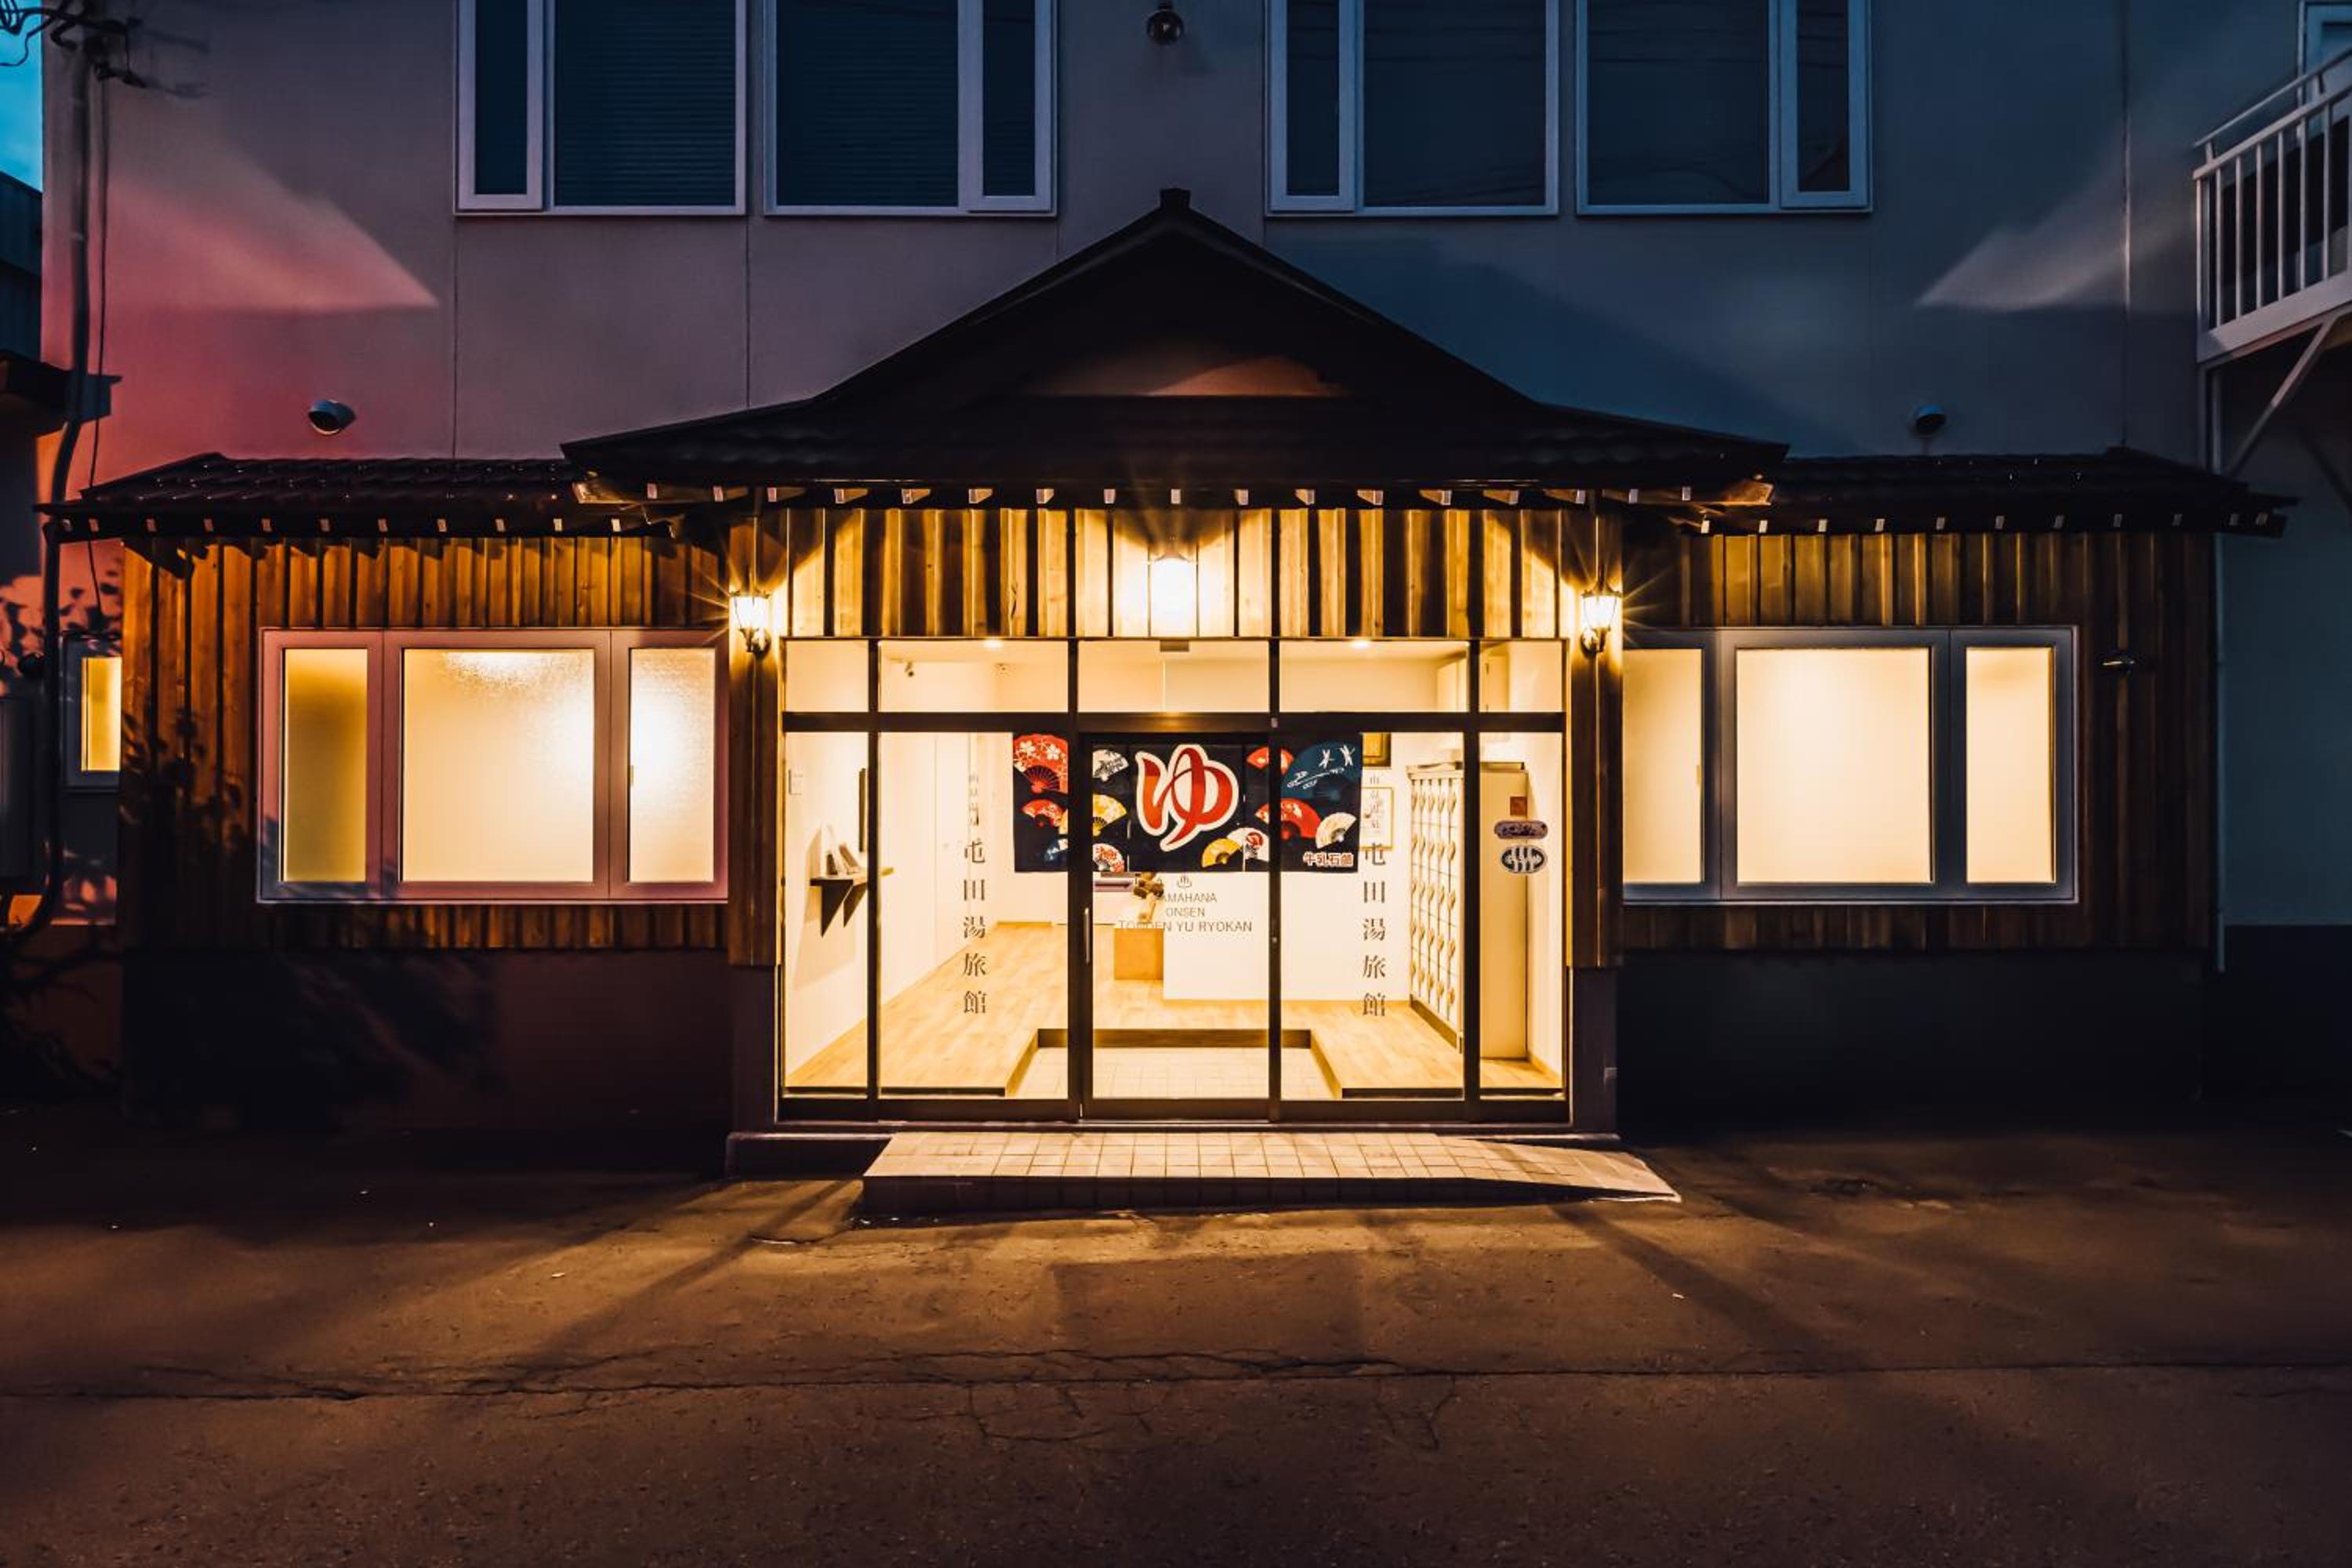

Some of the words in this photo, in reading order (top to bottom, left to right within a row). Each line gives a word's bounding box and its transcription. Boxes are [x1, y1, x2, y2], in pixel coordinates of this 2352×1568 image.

[1136, 744, 1239, 851] ゆ
[963, 838, 987, 1014] 屯田湯旅館
[1155, 892, 1218, 902] AMAHANA
[1165, 907, 1205, 916] ONSEN
[1176, 920, 1194, 932] YU
[1199, 920, 1252, 932] RYOKAN
[1362, 842, 1386, 1017] 屯田湯旅館
